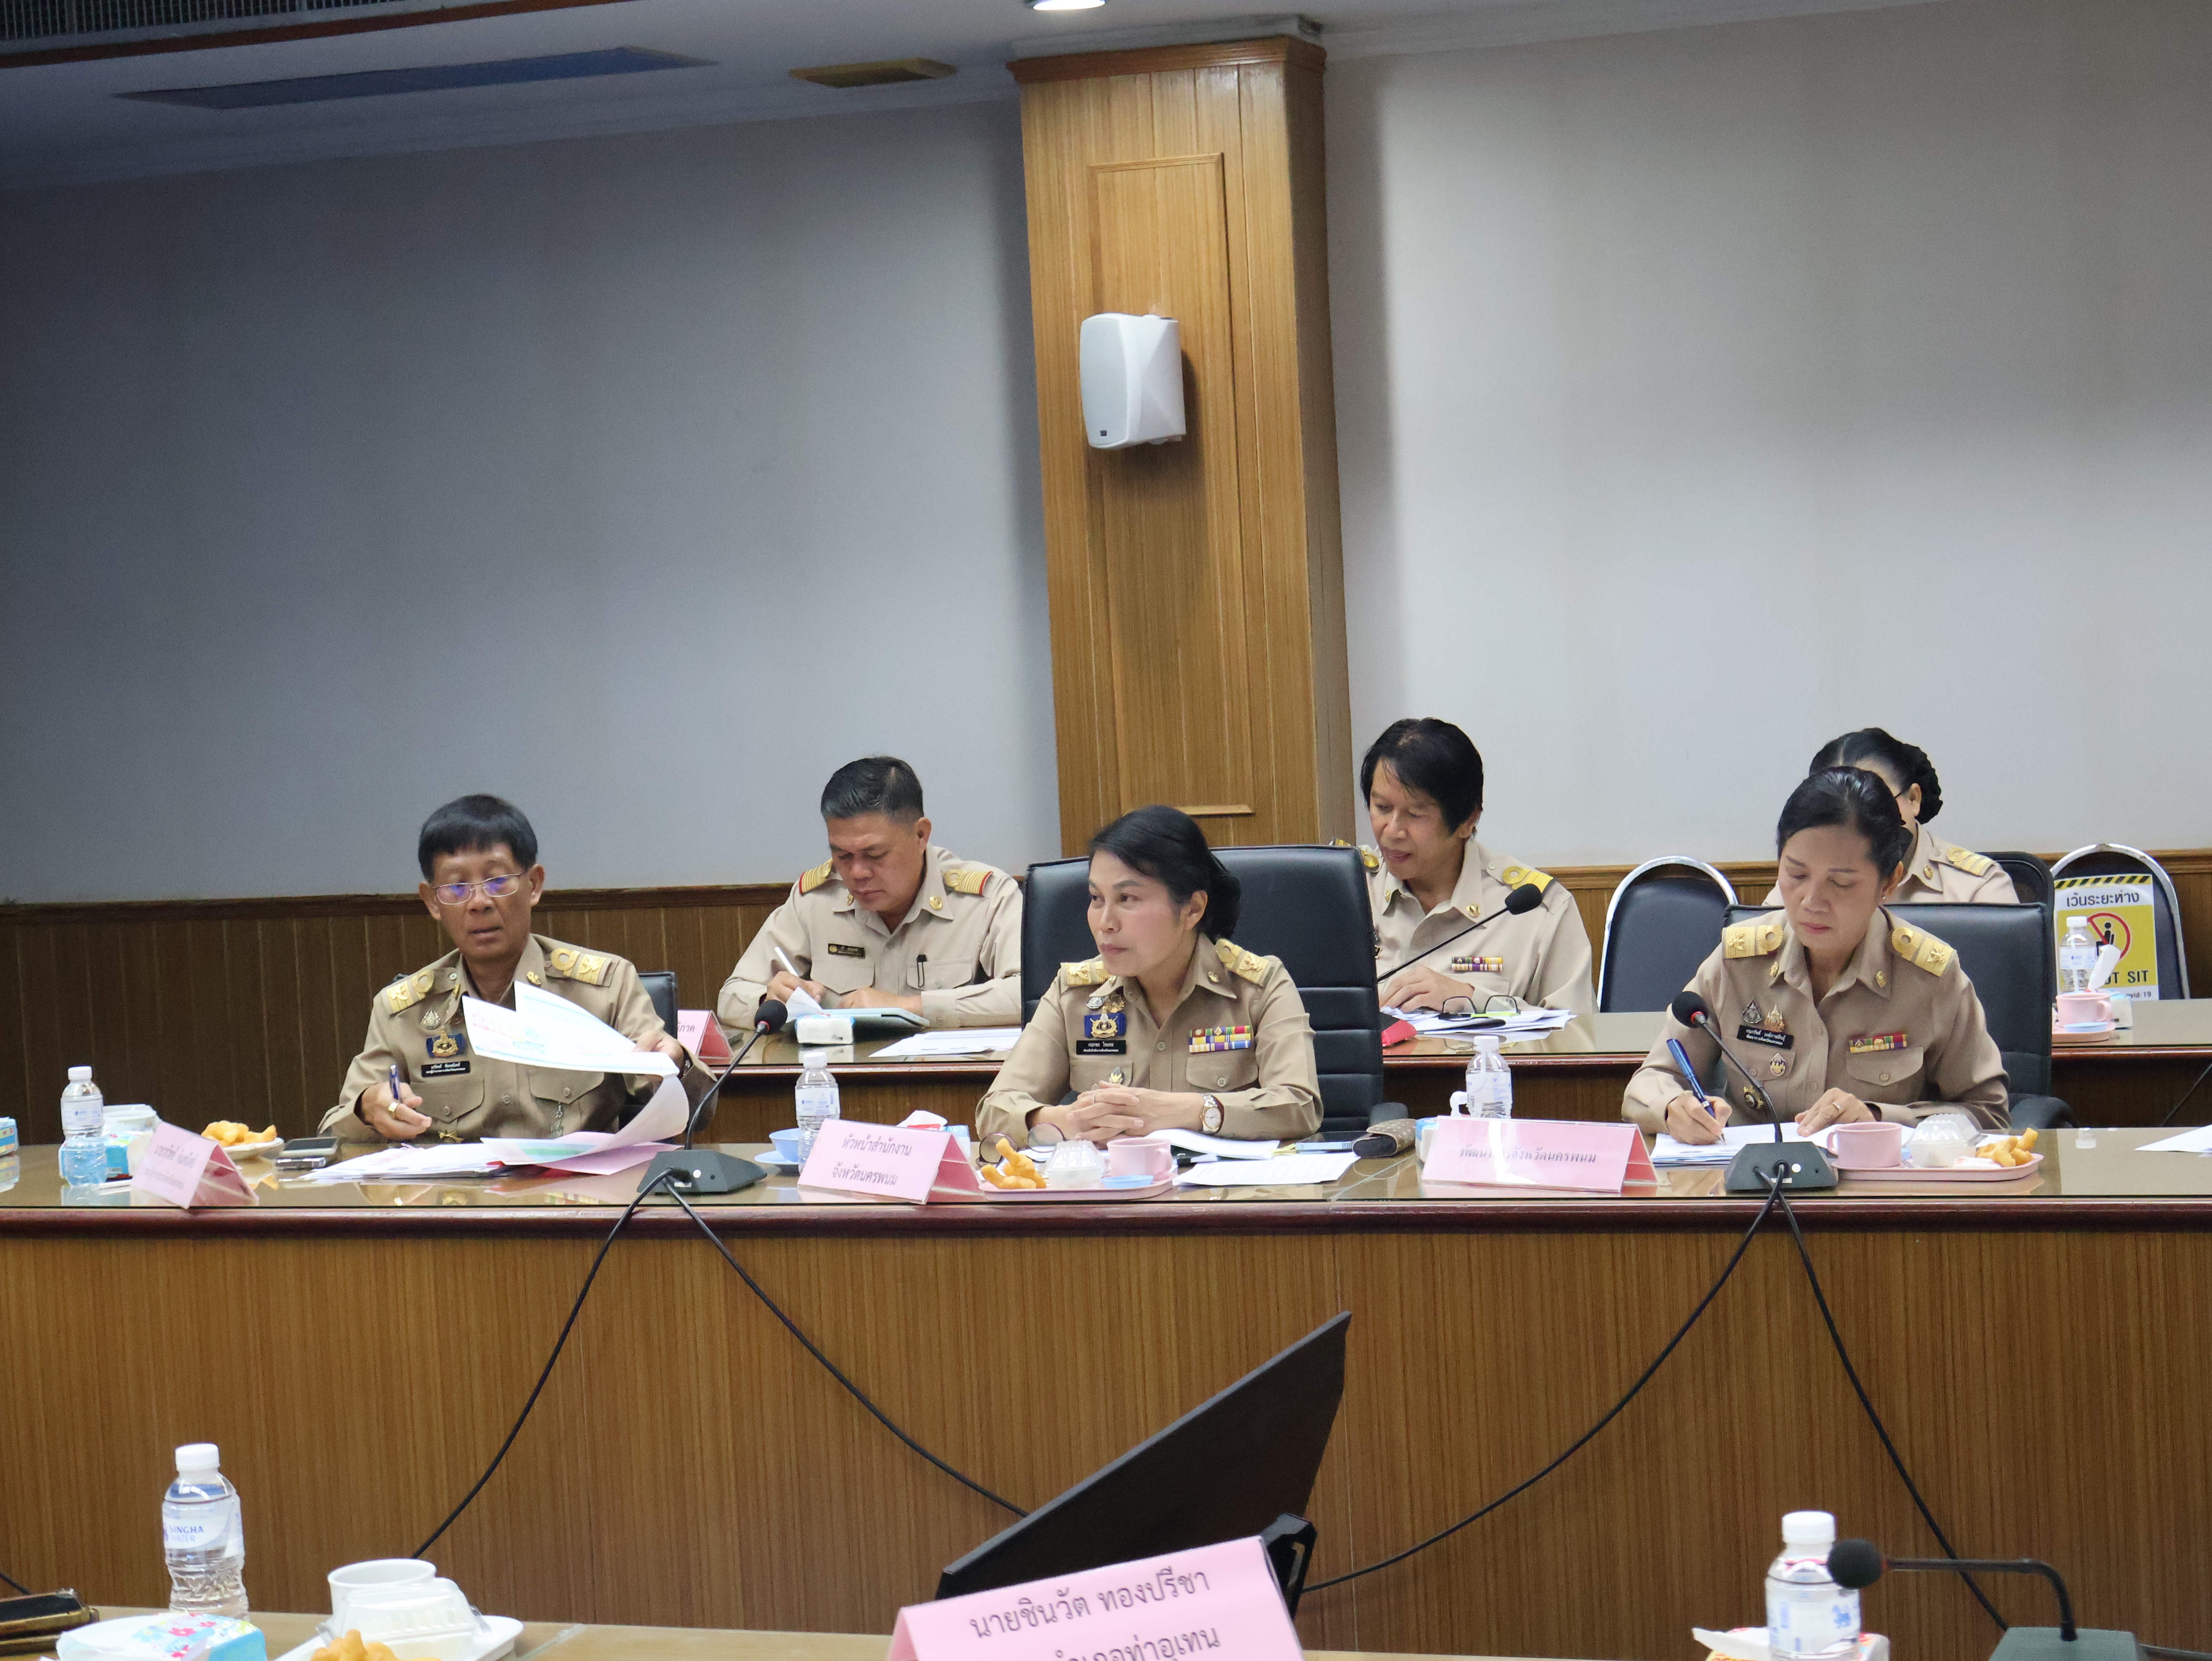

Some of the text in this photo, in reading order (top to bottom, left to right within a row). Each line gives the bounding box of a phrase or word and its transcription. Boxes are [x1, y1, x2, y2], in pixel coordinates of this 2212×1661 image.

[2067, 889, 2139, 907] เว้นระยะห่าง
[2128, 970, 2148, 983] SIT
[842, 1133, 913, 1156] หัวหน้าสำนักงาน
[1460, 1144, 1596, 1163] พัฒนารจังหวัดนครพนม
[832, 1162, 898, 1186] จังหวัดนครพนม
[969, 1566, 1211, 1638] นายชินวัต ทองปรีชา
